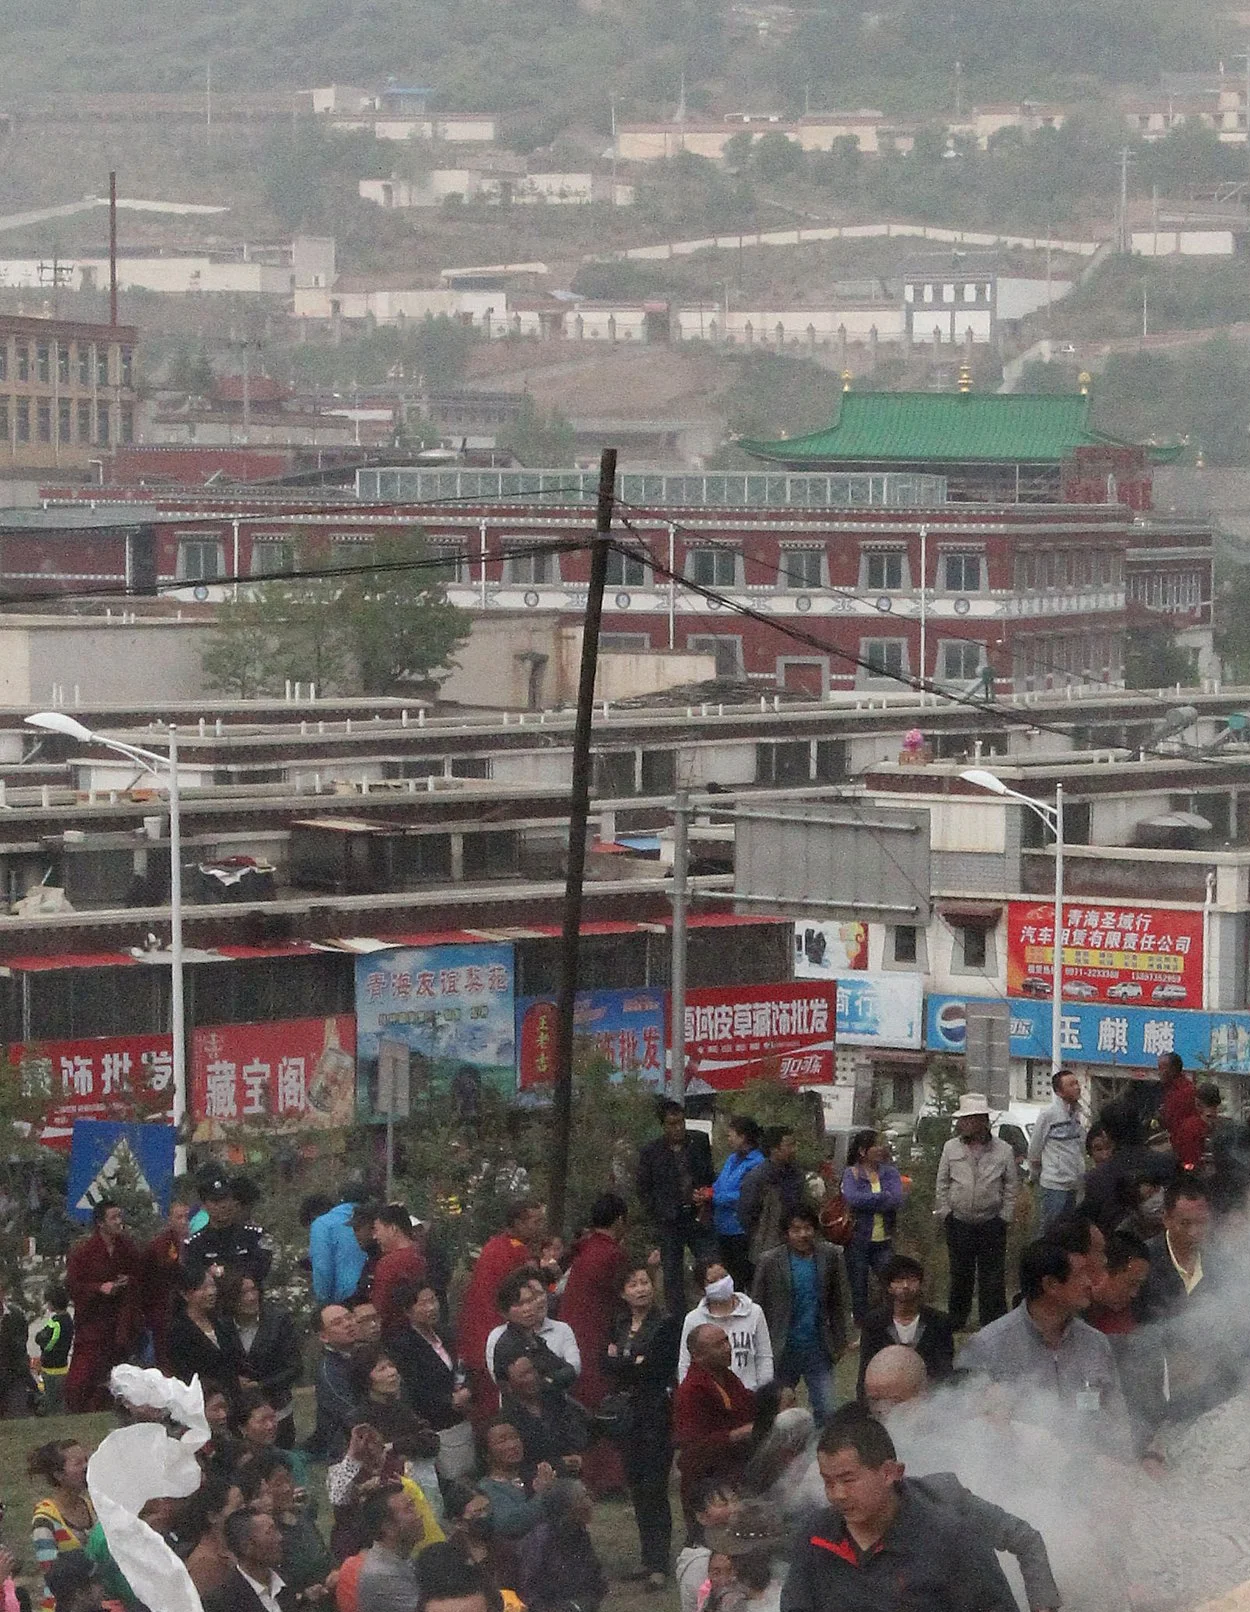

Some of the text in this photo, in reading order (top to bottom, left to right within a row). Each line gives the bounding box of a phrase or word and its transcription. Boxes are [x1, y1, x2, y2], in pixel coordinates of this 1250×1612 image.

[1067, 909, 1153, 932] 青海圣域行
[1020, 925, 1192, 955] 汽车租赁有限责任公司
[1060, 1016, 1175, 1056] 玉麒麟
[206, 1056, 306, 1117] 藏宝阁
